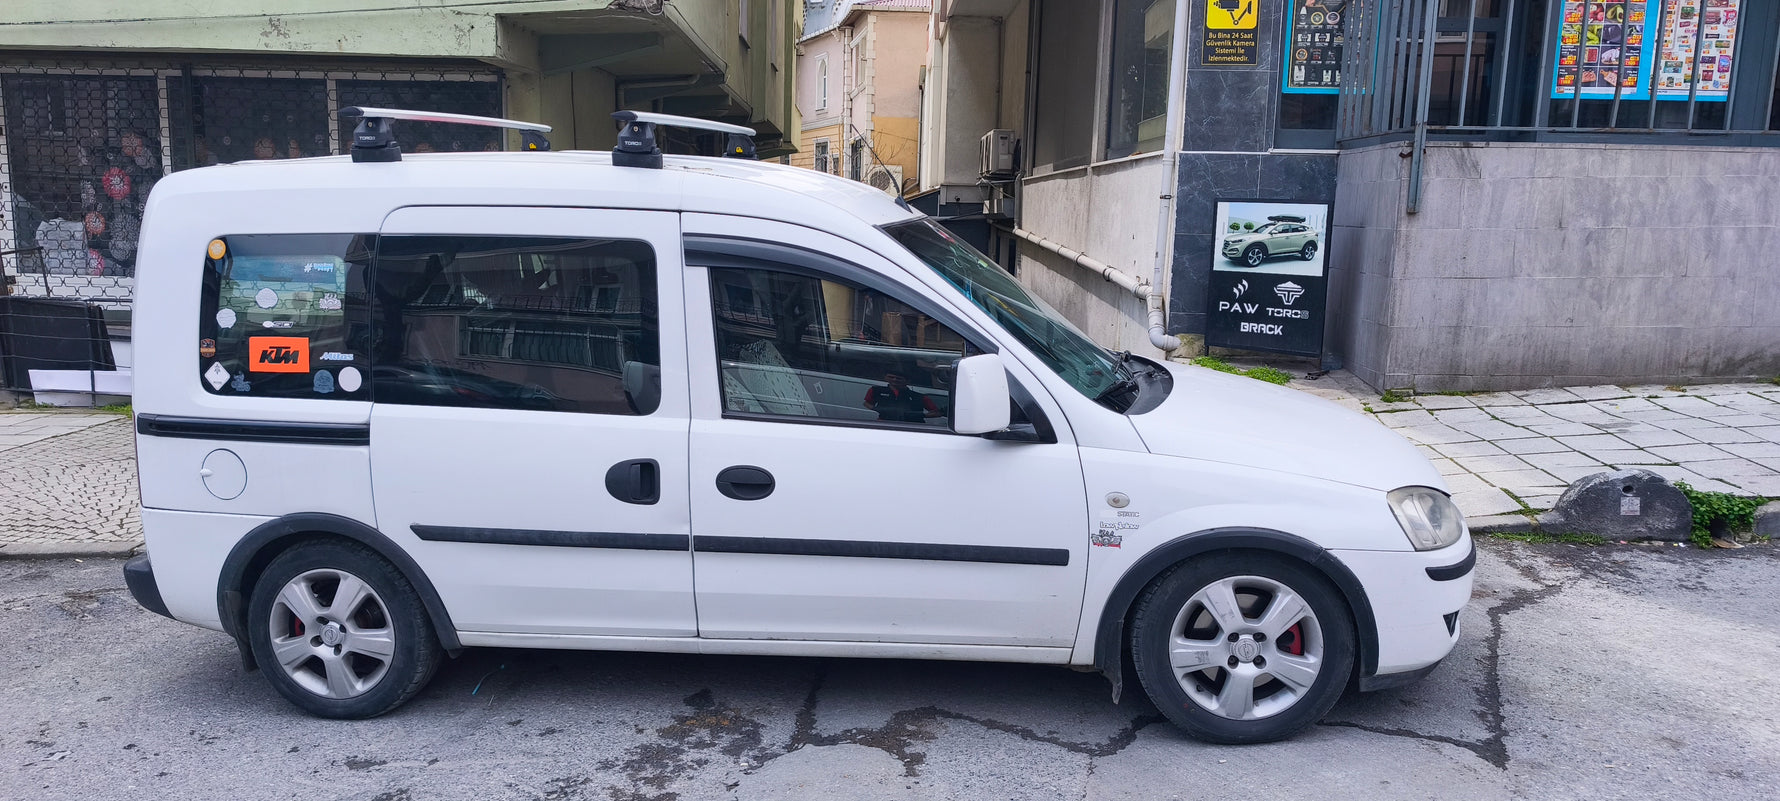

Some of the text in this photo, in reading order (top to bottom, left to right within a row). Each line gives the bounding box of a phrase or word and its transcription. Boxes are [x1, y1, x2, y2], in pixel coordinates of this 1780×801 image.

[1205, 39, 1232, 47] Güvenlik
[1219, 301, 1259, 314] PAW
[1266, 307, 1310, 320] TOROS
[1240, 321, 1284, 336] BRACK
[259, 346, 300, 364] KTM
